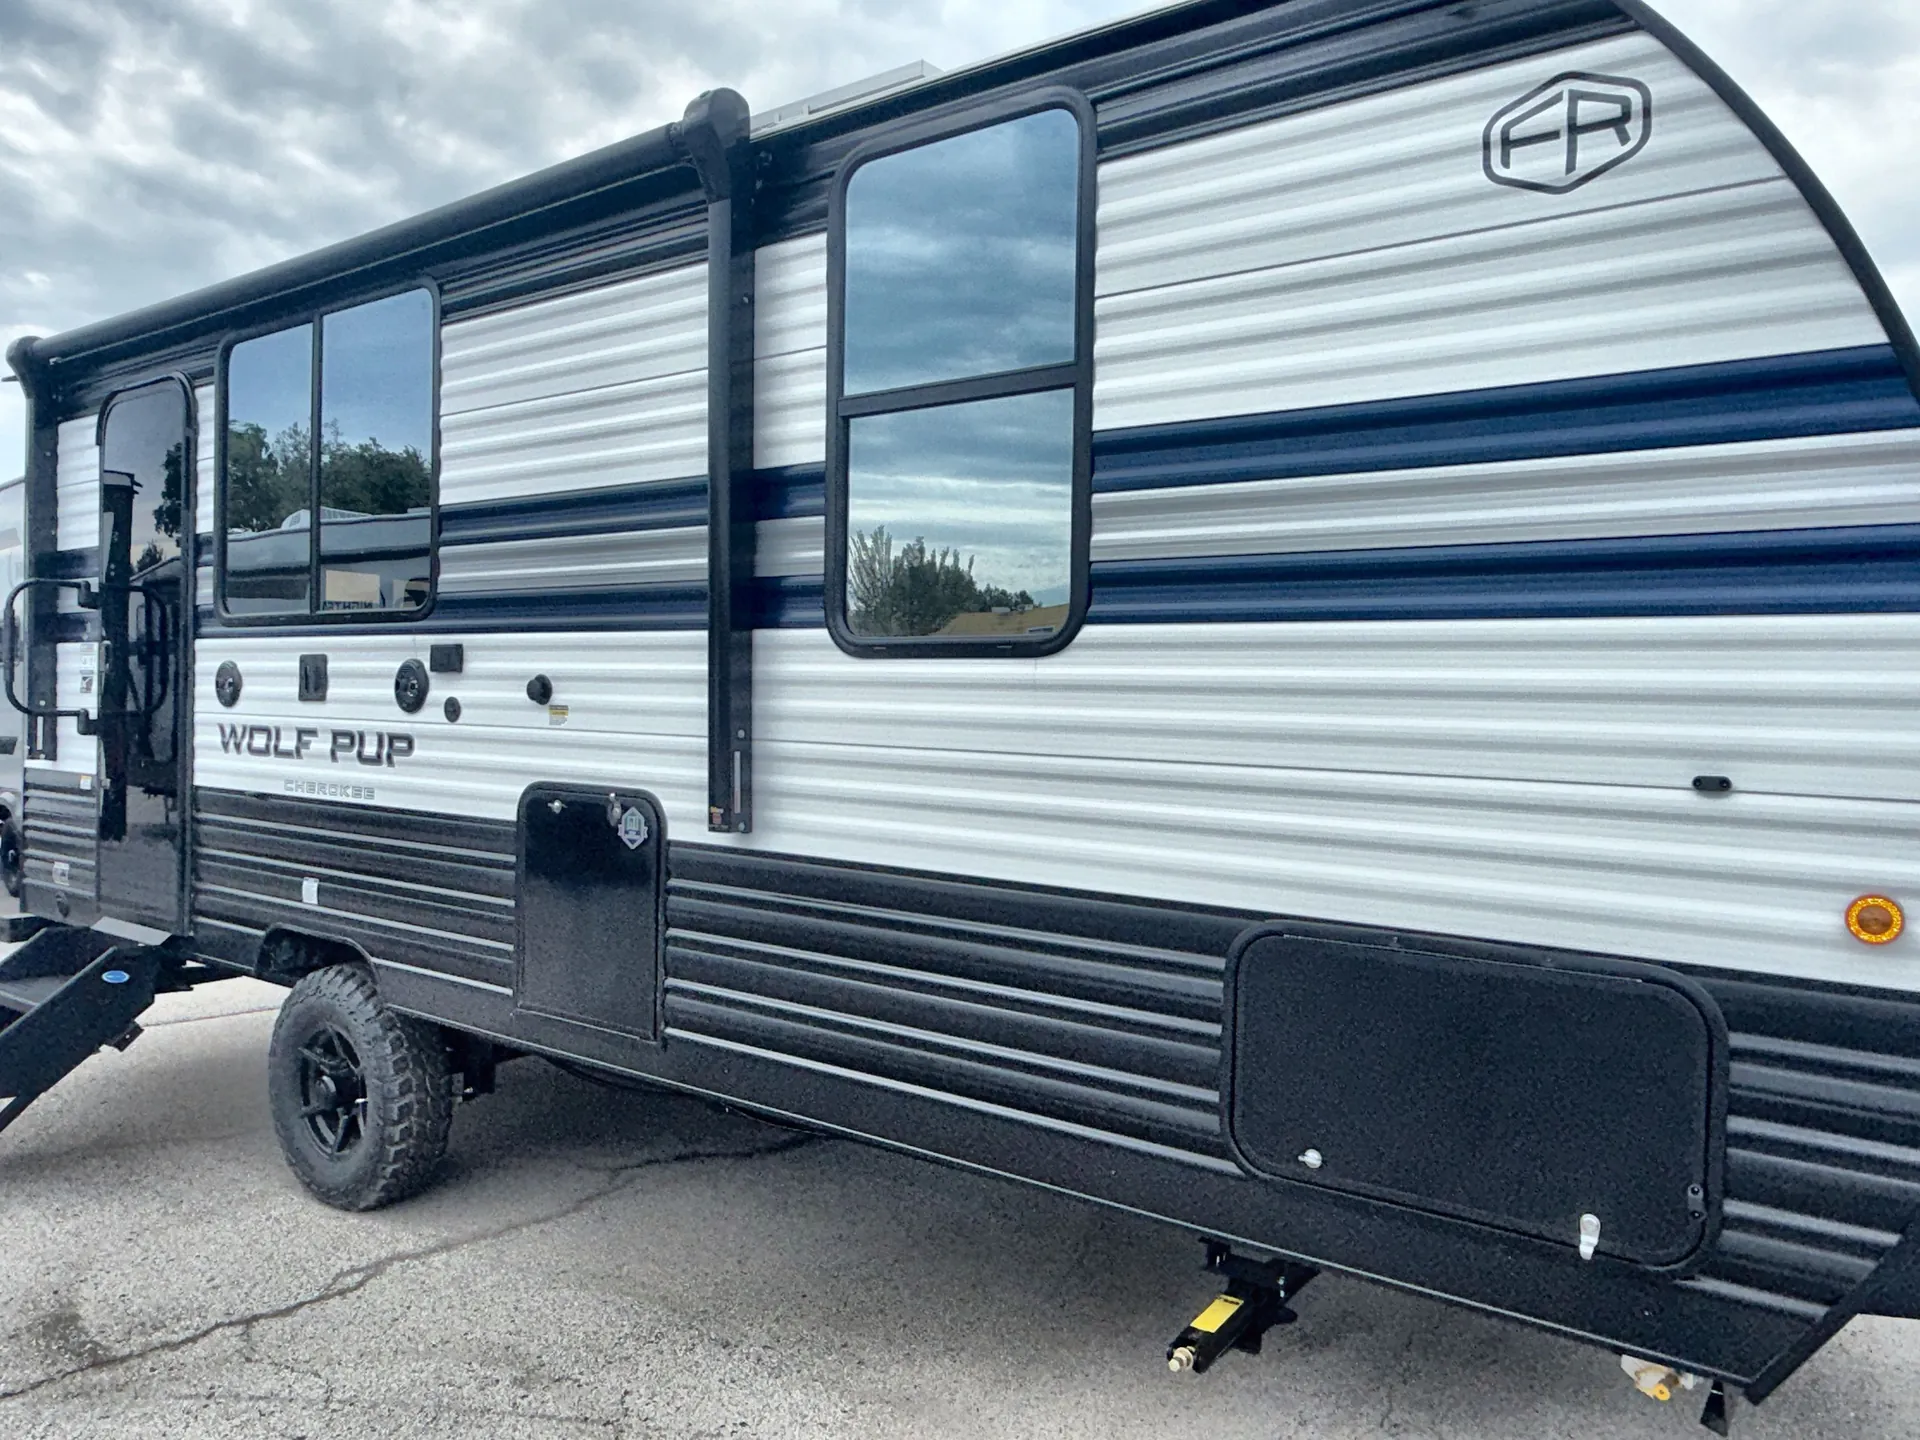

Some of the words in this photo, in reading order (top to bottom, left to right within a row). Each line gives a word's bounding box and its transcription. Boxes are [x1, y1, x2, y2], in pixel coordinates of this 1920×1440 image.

[218, 723, 318, 760] WOLF
[330, 729, 415, 767] PUP
[284, 779, 375, 800] CHEROKEE
